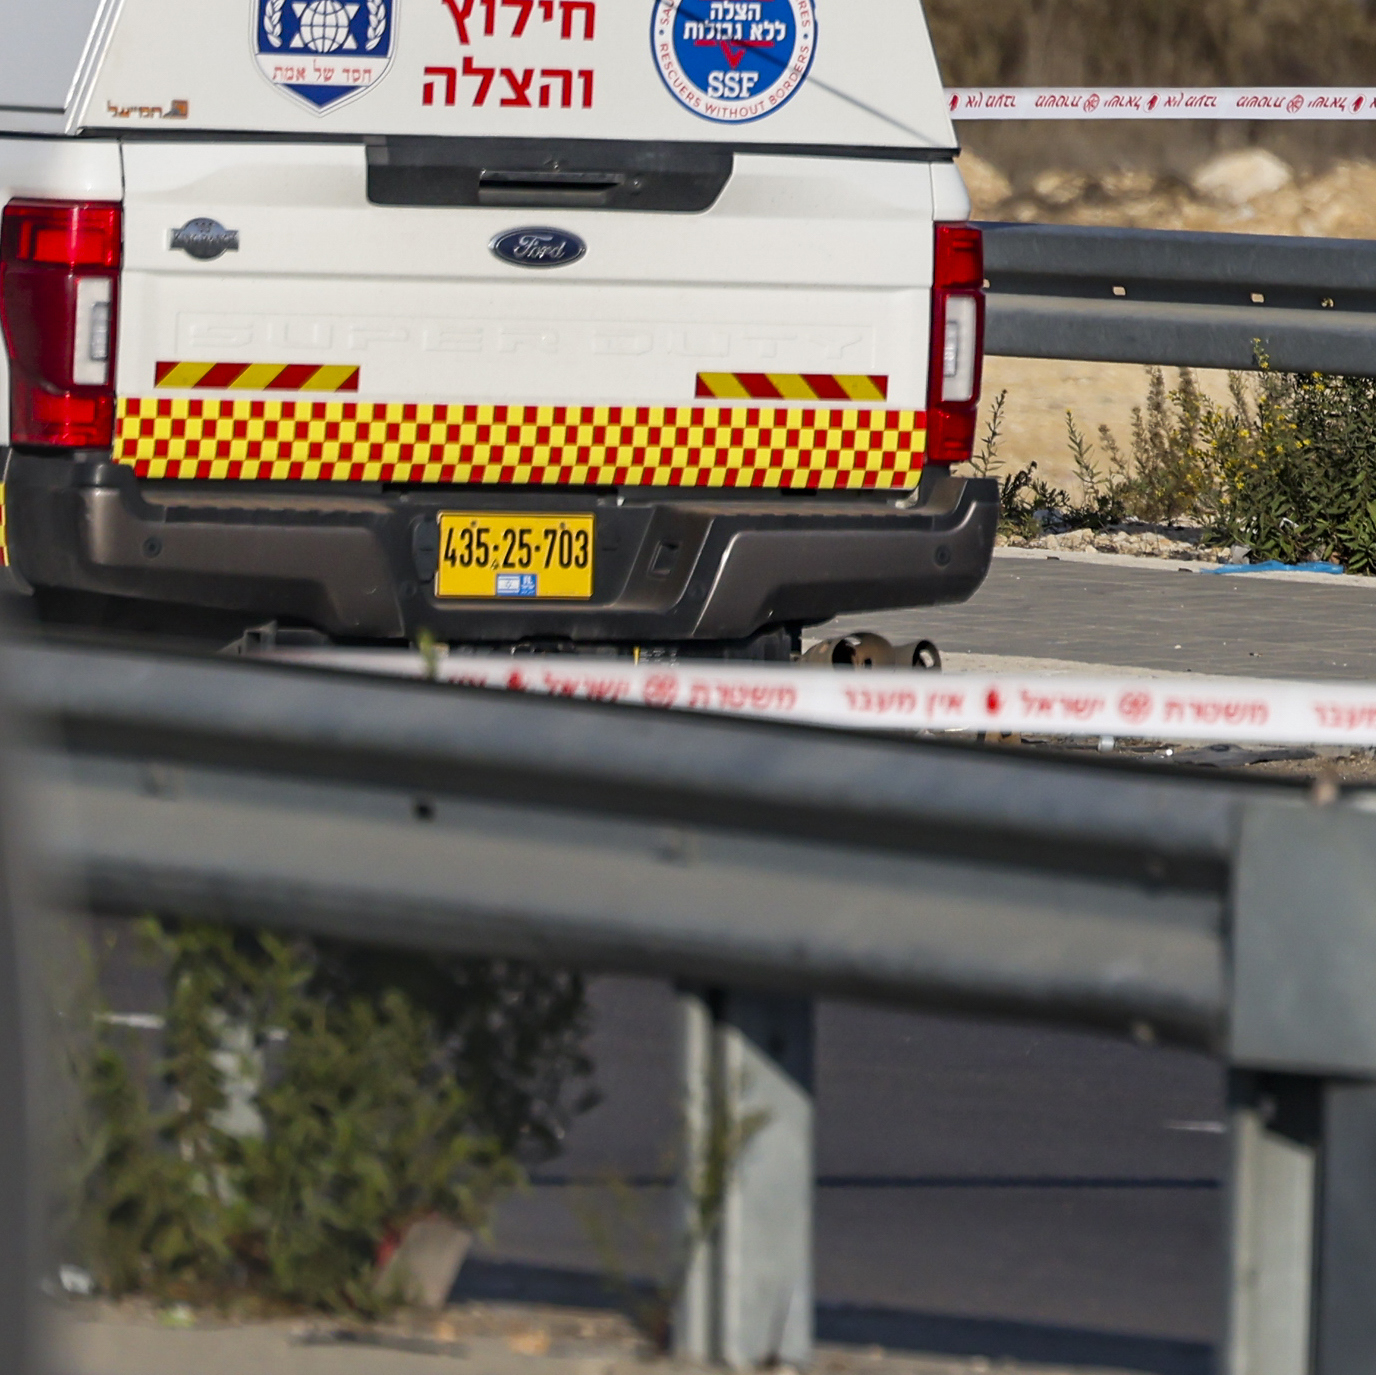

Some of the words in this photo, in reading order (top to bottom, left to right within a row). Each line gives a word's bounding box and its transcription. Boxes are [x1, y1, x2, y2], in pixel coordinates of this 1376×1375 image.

[709, 0, 762, 22] הצלה
[683, 19, 744, 41] גבולות
[750, 19, 786, 42] ללא
[272, 65, 307, 81] אמת
[313, 58, 335, 81] של
[342, 67, 373, 82] חסד
[423, 57, 593, 108] והצלה
[659, 43, 701, 108] RESCUERS
[705, 100, 767, 120] WITHOUT
[769, 45, 810, 106] BORDERS
[707, 70, 759, 98] SSF
[513, 234, 567, 259] Ford
